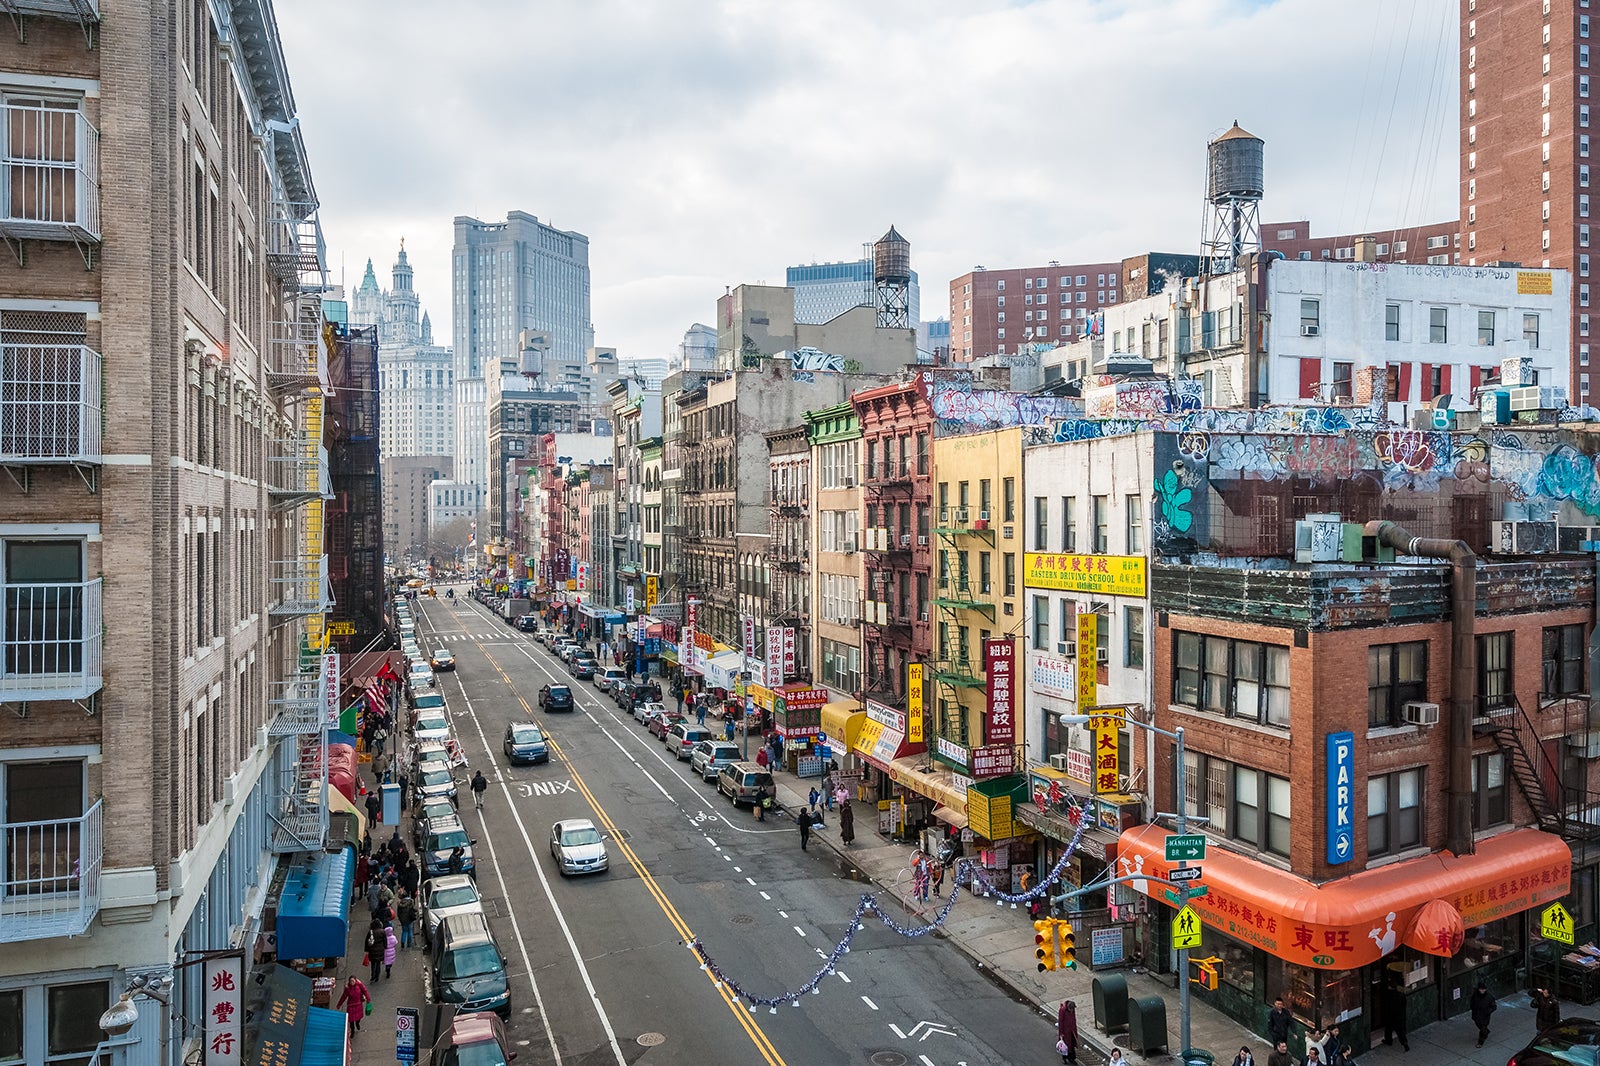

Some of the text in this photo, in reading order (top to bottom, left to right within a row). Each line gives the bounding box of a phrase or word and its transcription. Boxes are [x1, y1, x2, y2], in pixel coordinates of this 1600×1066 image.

[1031, 570, 1115, 583] EASTERN DRIVING SCHOOL
[1098, 733, 1118, 790] 大酒樓
[1337, 745, 1349, 827] PARK
[1168, 839, 1203, 847] MANHATTAN
[1171, 849, 1180, 857] BR
[1174, 869, 1198, 879] ONE WAY
[1463, 913, 1478, 926] EAST
[1291, 924, 1354, 954] 東旺
[1545, 928, 1571, 941] AHEAD
[1316, 955, 1332, 965] 70
[210, 969, 236, 1055] 兆豐行
